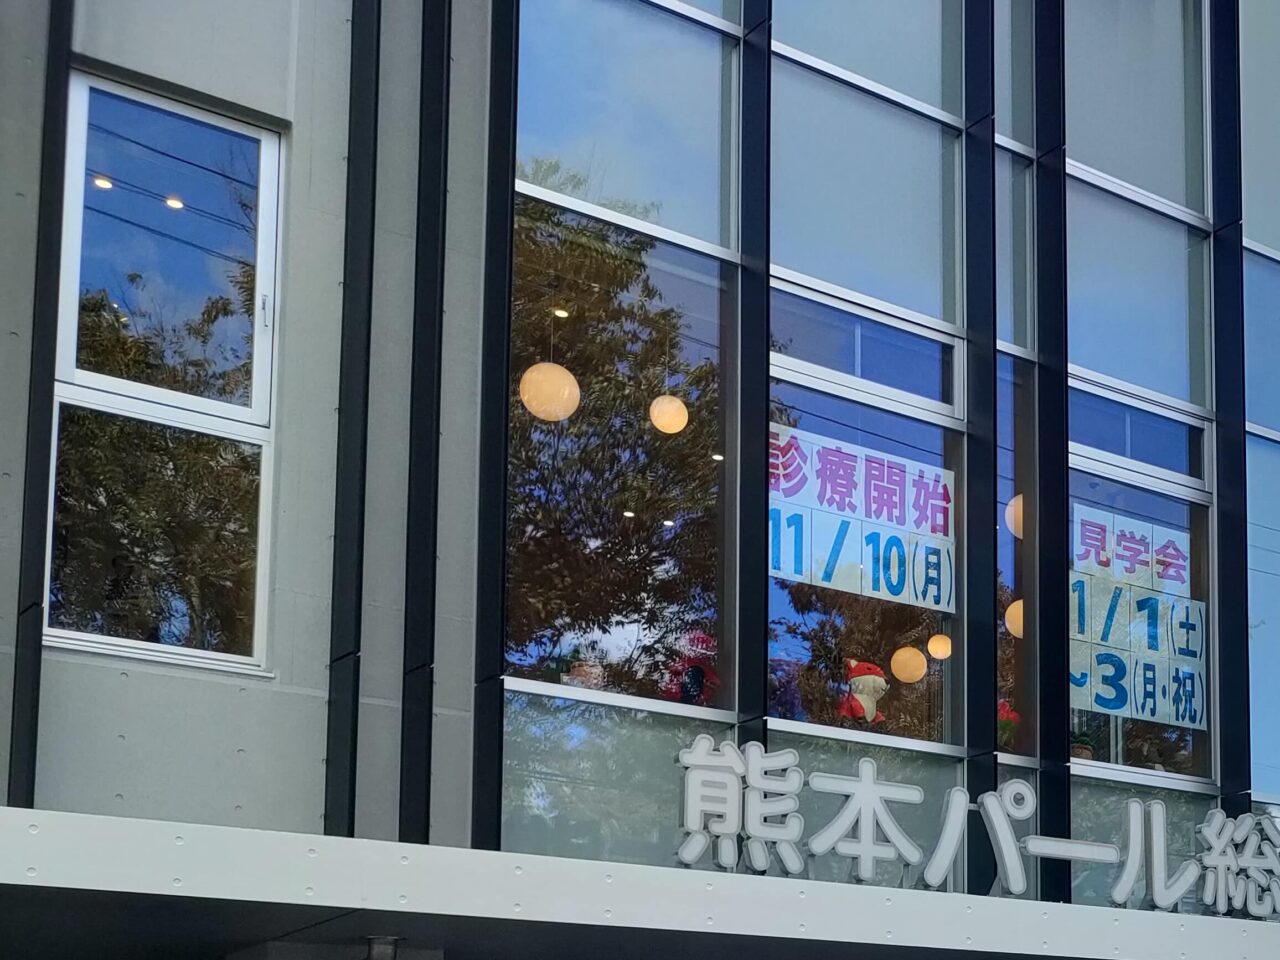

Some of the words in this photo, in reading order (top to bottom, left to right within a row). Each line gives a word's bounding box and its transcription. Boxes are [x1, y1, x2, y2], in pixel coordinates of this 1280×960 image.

[769, 431, 951, 537] 診療開始
[1075, 519, 1189, 584] 見学会
